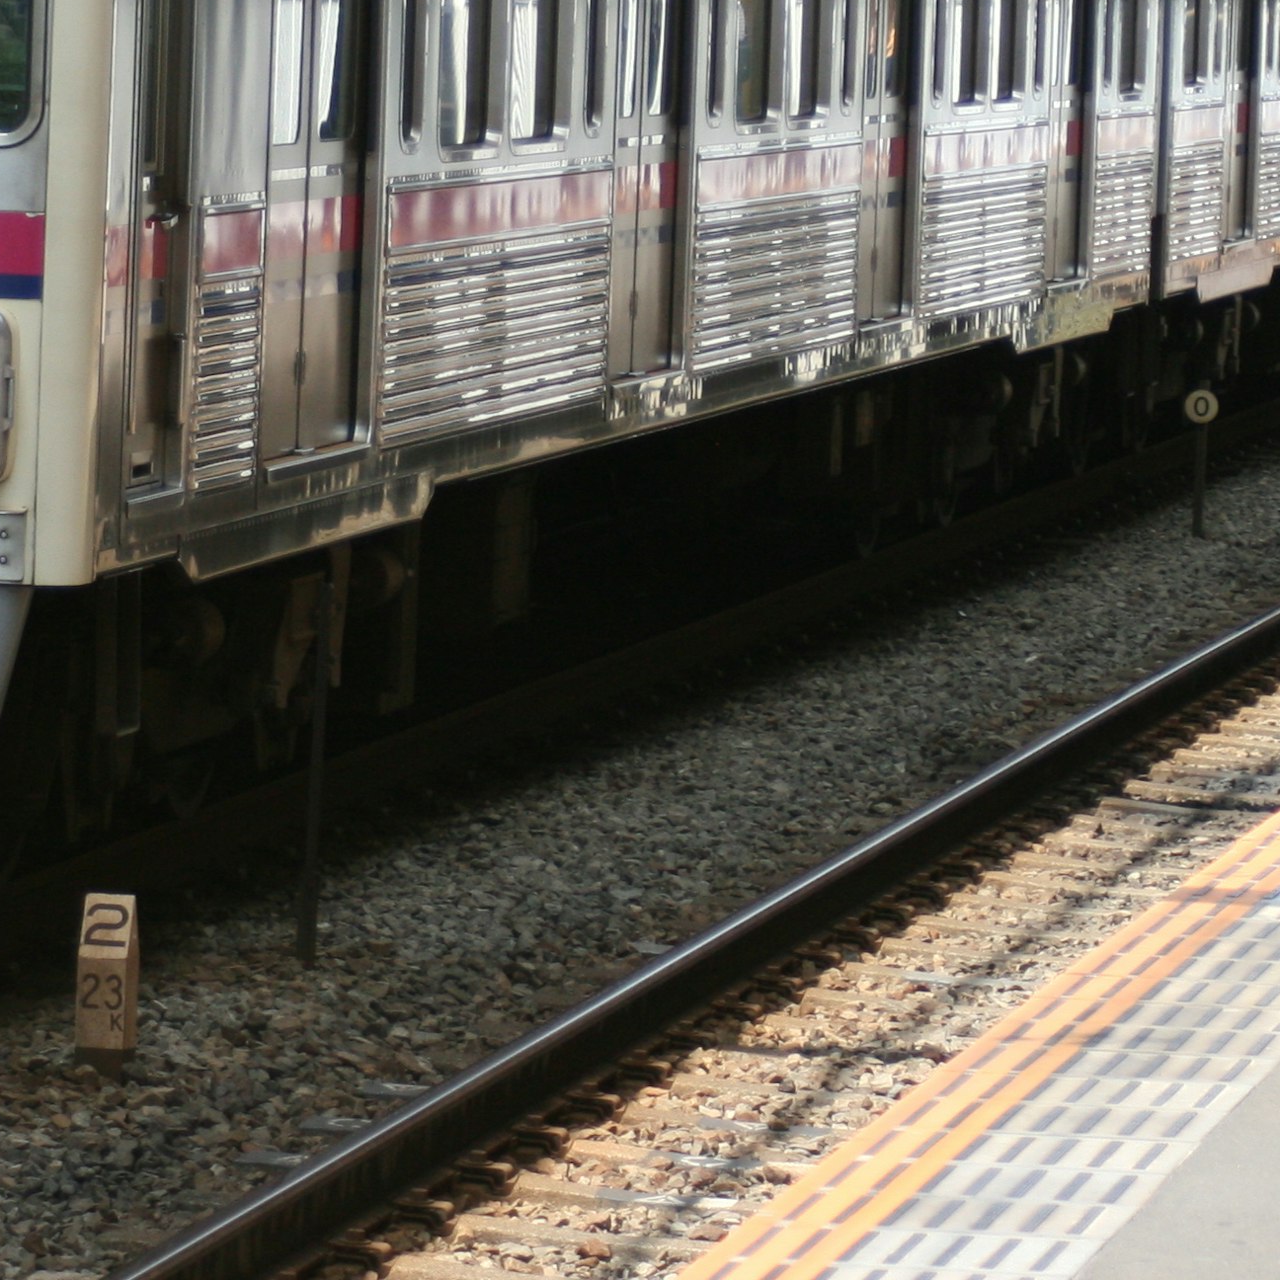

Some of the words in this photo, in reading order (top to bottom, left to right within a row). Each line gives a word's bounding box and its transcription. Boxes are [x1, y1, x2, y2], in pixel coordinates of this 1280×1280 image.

[84, 903, 129, 947] 2
[80, 973, 123, 1010] 23
[109, 1013, 124, 1032] K
